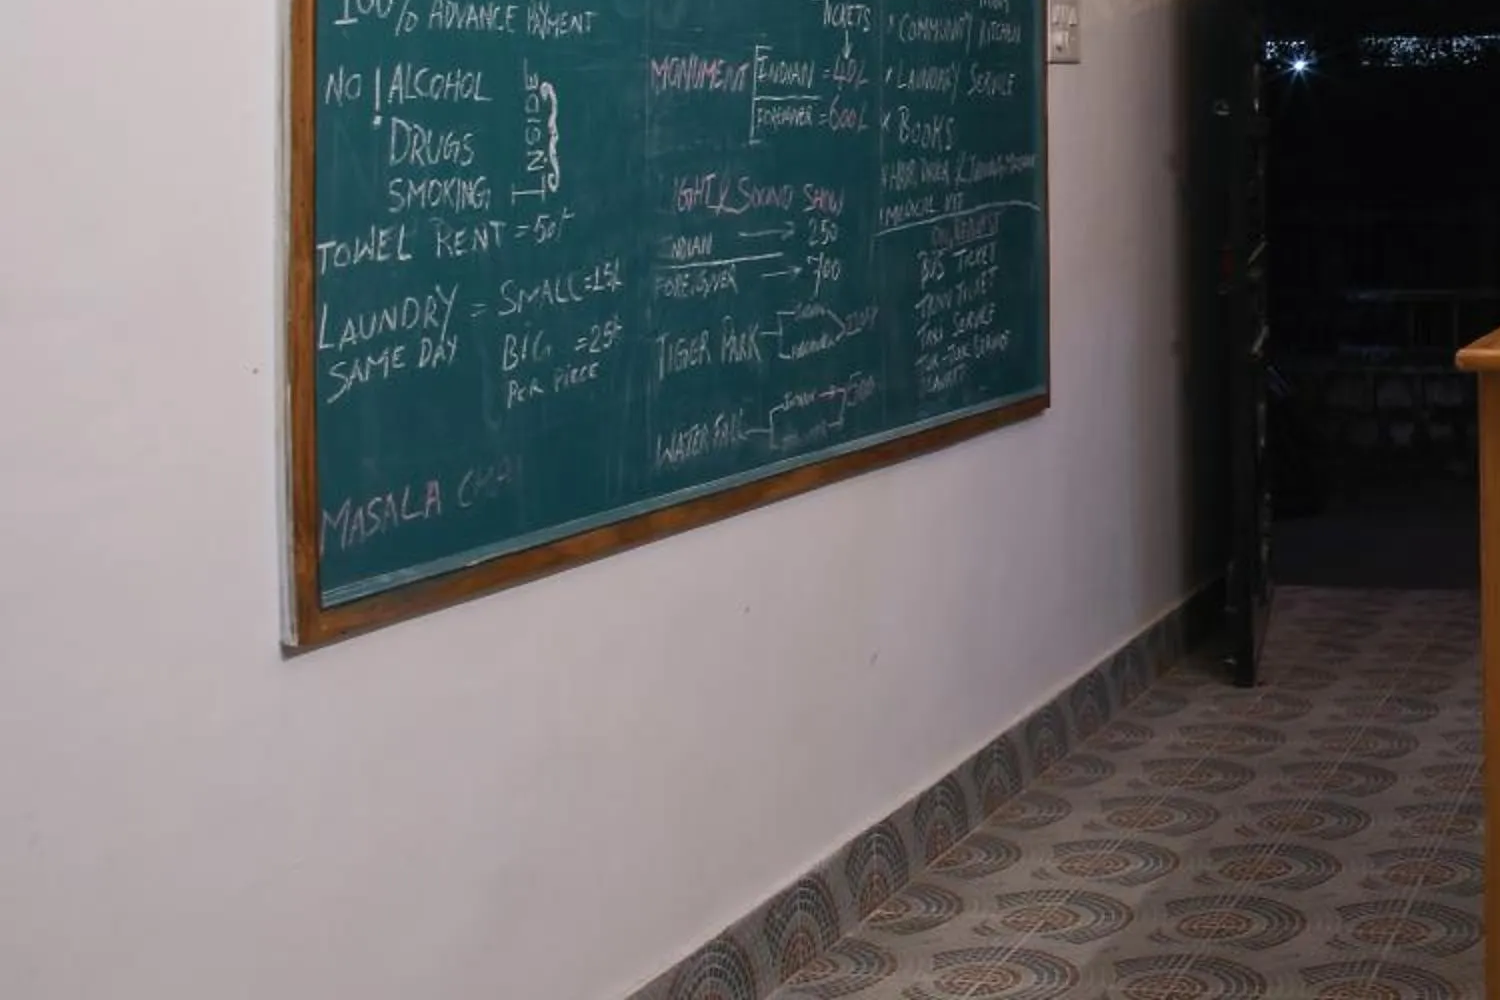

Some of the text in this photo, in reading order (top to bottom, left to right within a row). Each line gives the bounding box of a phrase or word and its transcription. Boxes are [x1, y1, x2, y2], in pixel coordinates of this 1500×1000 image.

[325, 64, 362, 106] NO
[388, 62, 493, 105] ALCOHOL
[389, 116, 475, 167] DRUGS
[316, 223, 413, 275] TOWEL
[430, 216, 506, 258] RENT
[318, 282, 459, 350] LAUNDRY
[327, 334, 458, 404] SAME DAY
[319, 478, 442, 556] MASALA
